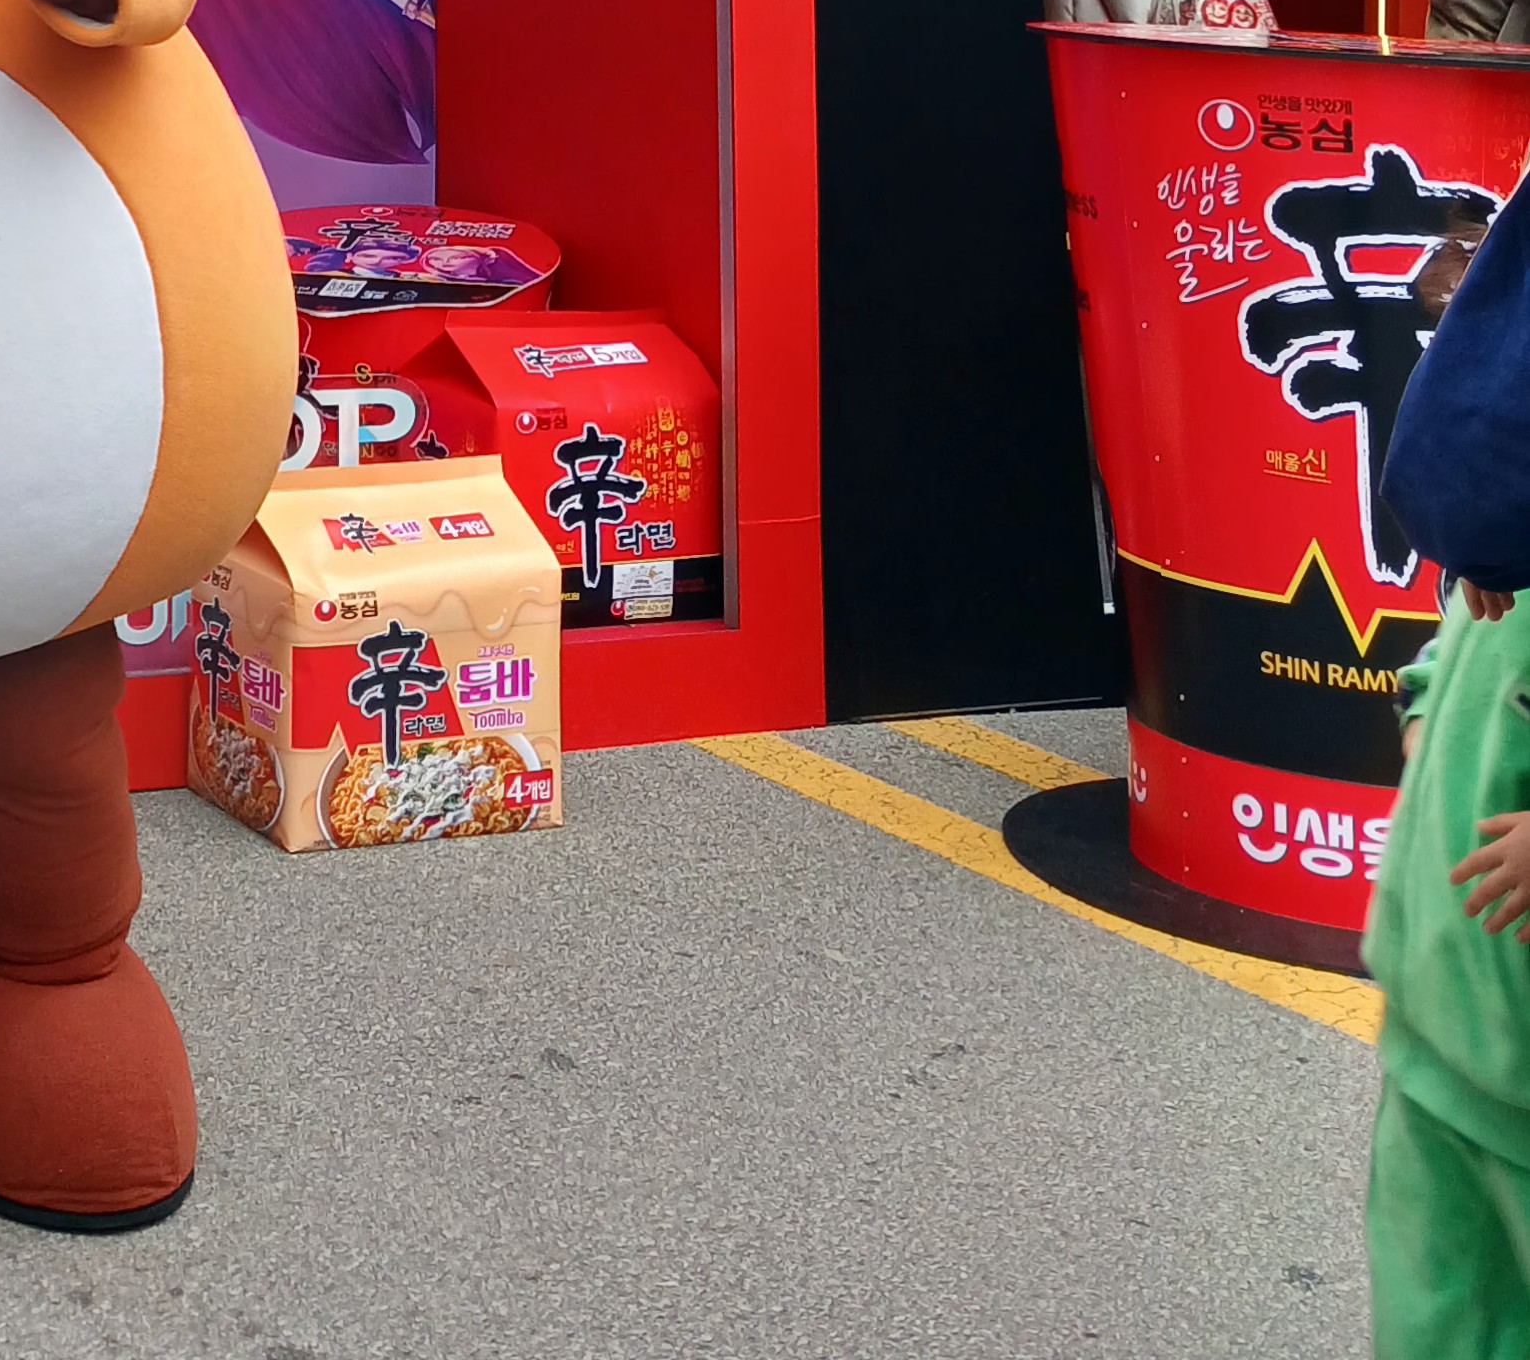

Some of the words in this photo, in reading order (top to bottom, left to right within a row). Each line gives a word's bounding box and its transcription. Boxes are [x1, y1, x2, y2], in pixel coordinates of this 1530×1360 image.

[1258, 94, 1301, 110] 인생을
[1305, 97, 1352, 115] 맛있게
[1258, 112, 1354, 153] 농심
[1158, 162, 1241, 216] 인생을
[1166, 218, 1271, 302] 울리는
[1265, 448, 1326, 477] 매울신
[546, 423, 647, 588] 辛
[616, 522, 674, 554] 라면
[340, 513, 379, 555] 辛
[440, 518, 489, 537] 4개입
[340, 600, 378, 619] 농심
[195, 595, 240, 725] 辛
[457, 658, 535, 704] 툼바
[1261, 652, 1320, 684] SHIN
[1327, 664, 1401, 695] RAMY
[242, 657, 285, 712] 툼바
[348, 619, 448, 772] 辛
[403, 714, 446, 736] 라면
[468, 708, 523, 729] Toomba
[506, 775, 551, 803] 4개입
